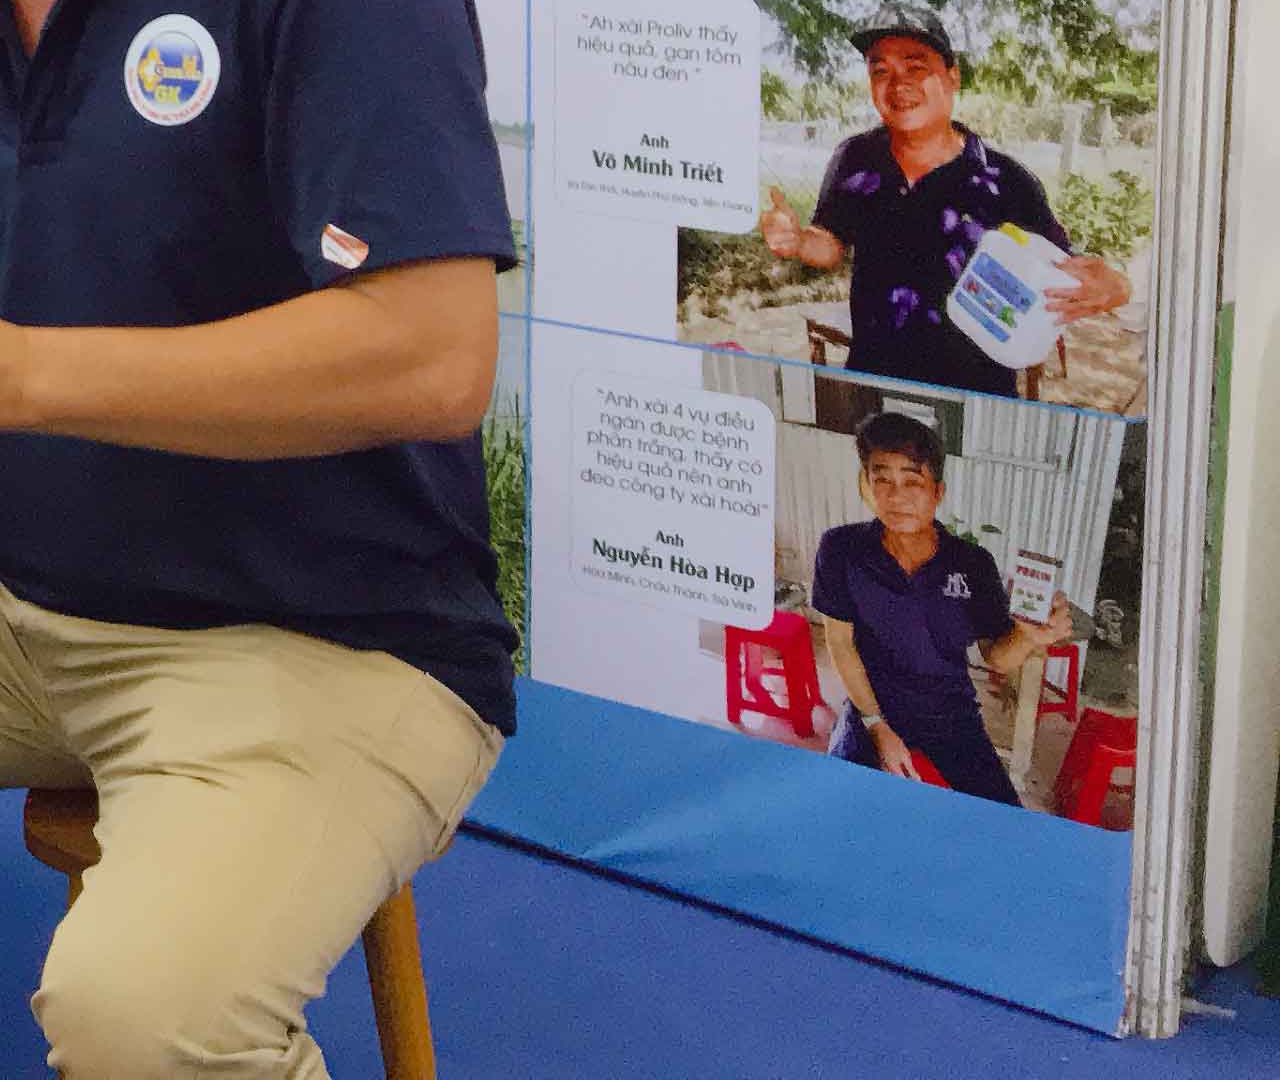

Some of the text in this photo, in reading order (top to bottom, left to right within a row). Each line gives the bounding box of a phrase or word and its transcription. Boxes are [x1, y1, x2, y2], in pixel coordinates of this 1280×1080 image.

[640, 133, 670, 150] Anh
[593, 149, 724, 184] Võ Minh Triết
[655, 530, 685, 548] Anh
[592, 537, 664, 570] Nguyễn
[670, 554, 708, 580] Hòa
[715, 565, 755, 592] Hợp
